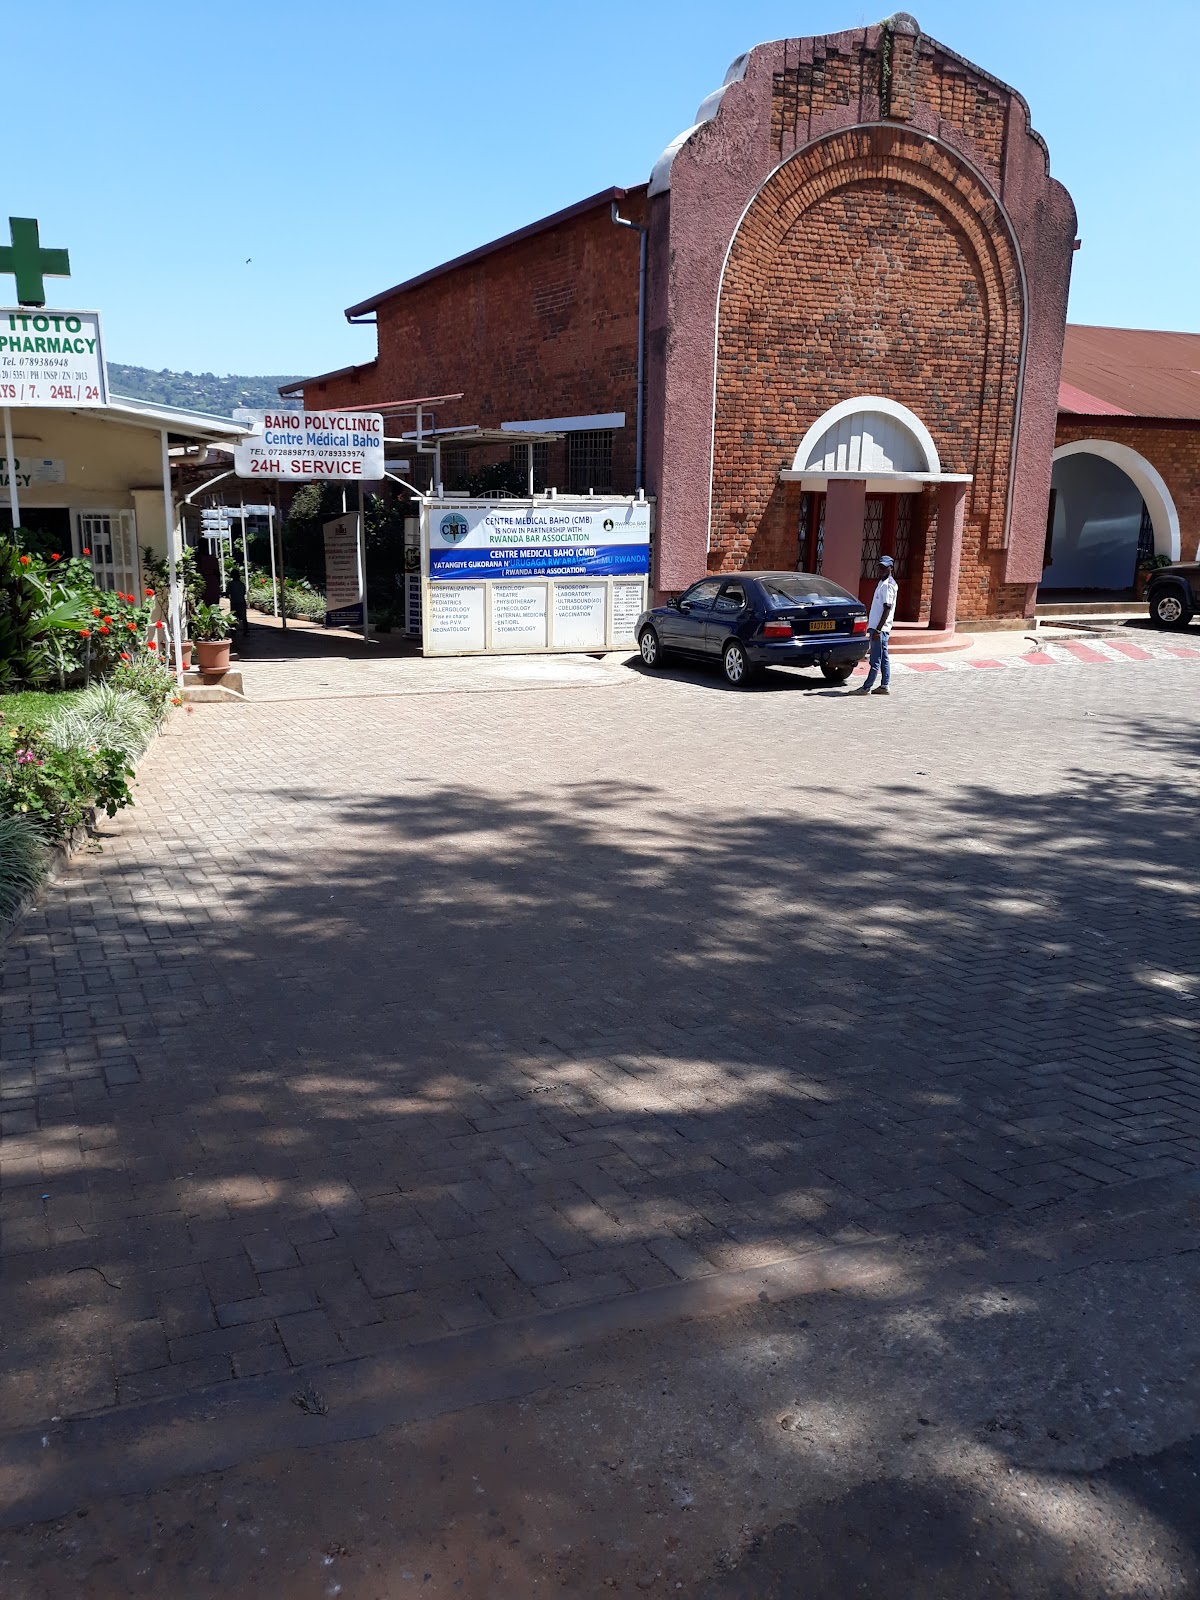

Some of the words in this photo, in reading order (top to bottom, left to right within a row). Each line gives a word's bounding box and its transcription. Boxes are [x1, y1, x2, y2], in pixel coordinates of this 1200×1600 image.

[9, 314, 81, 333] ITOTO
[0, 336, 96, 354] PHARMACY
[2, 357, 17, 366] Tel.
[19, 357, 69, 367] 0789386948
[30, 371, 39, 380] PH
[43, 371, 58, 380] INSP
[0, 384, 16, 398] YS
[264, 415, 300, 429] BAHO
[305, 416, 380, 432] POLYCLINIC
[265, 431, 303, 445] Centre
[306, 430, 349, 447] Médical
[353, 433, 380, 447] Baho
[250, 448, 266, 456] TEL
[250, 459, 285, 473] 24H.
[291, 460, 362, 474] SERVICE
[485, 517, 513, 525] CENTRE
[515, 517, 547, 525] MEDICAL
[549, 516, 570, 525] BAHO
[572, 516, 593, 525] (CMB)
[489, 535, 524, 543] RWANDA
[542, 534, 590, 542] ASSOCIATION
[490, 550, 519, 559] CENTRE
[519, 549, 552, 558] MEDICAL
[553, 548, 574, 557] BAHO
[575, 547, 597, 558] (CMB)
[433, 561, 467, 569] YATANGIYE
[468, 560, 502, 568] GUKORANA
[601, 556, 613, 564] MU
[614, 554, 647, 563] RWANDA
[505, 568, 533, 576] RWANDA
[533, 567, 545, 575] BAR
[546, 566, 586, 574] ASSOCIATION)
